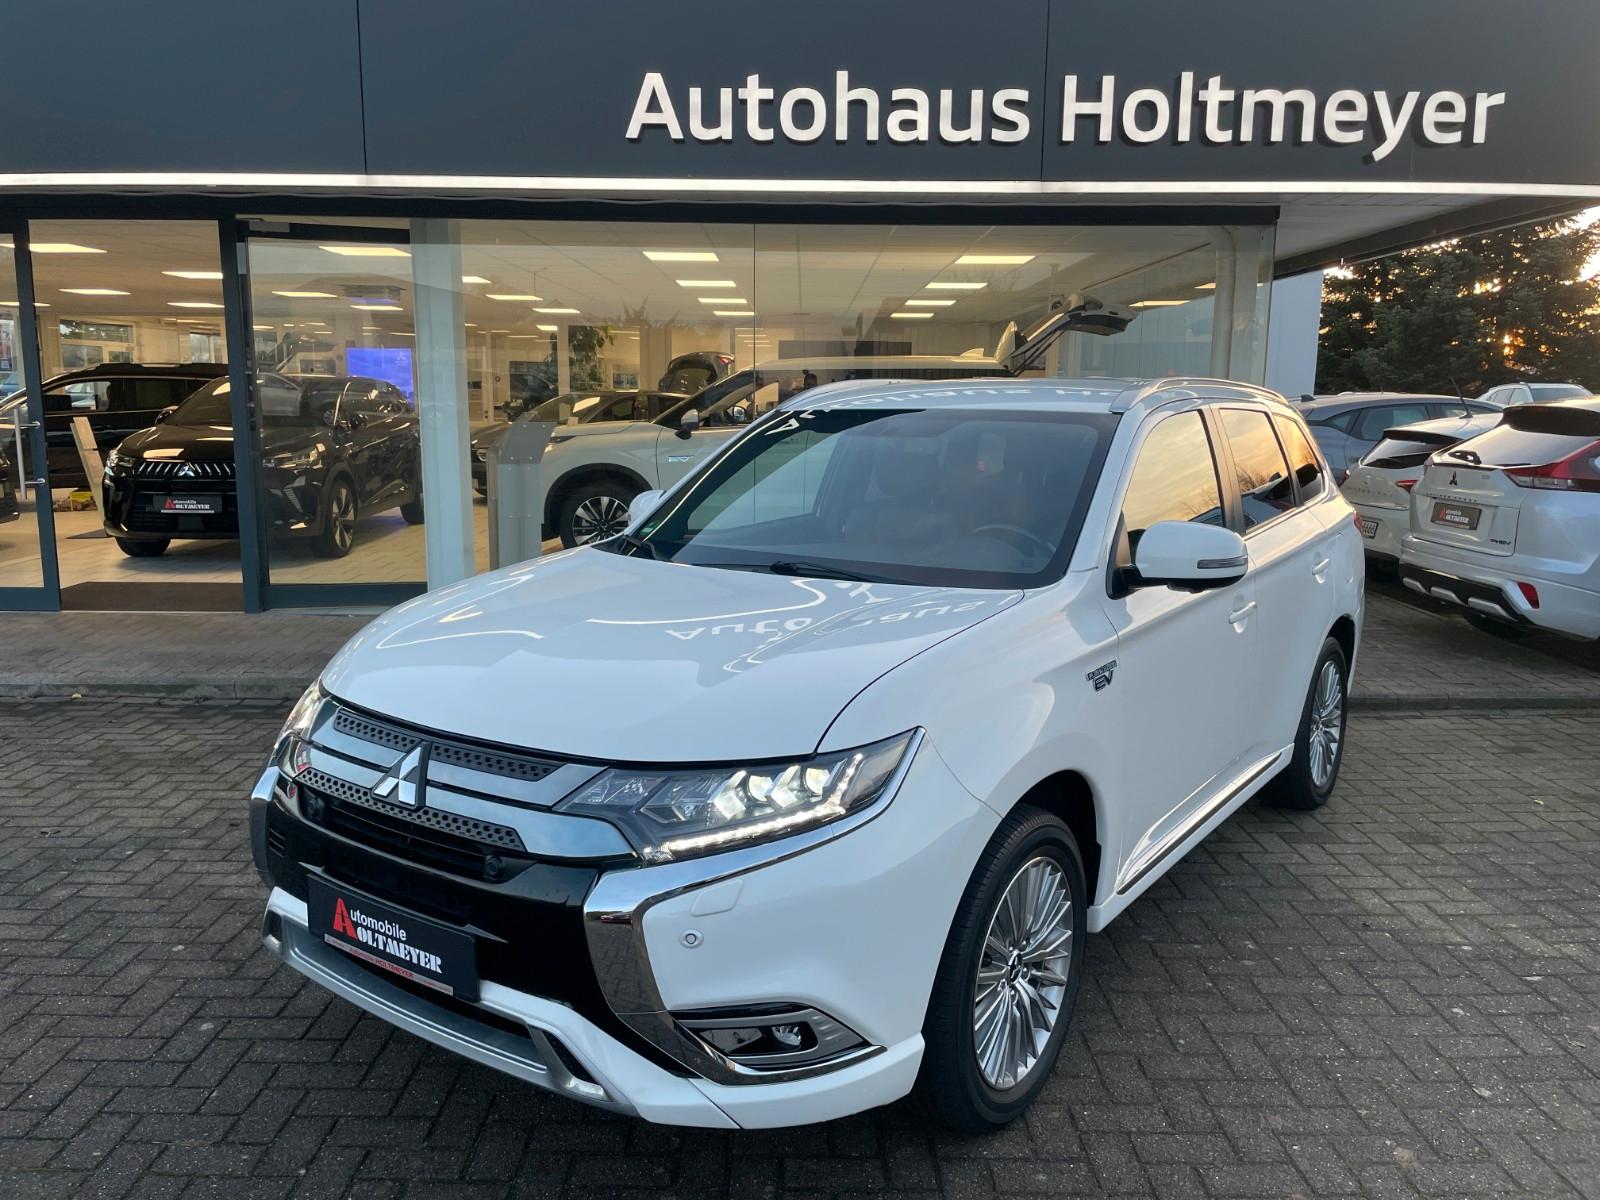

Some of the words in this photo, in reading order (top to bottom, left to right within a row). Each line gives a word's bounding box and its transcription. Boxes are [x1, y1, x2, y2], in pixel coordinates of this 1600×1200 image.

[624, 70, 1031, 143] Autohaus
[1060, 71, 1506, 163] Holtmeyer
[1092, 669, 1114, 691] EV
[333, 896, 407, 941] Automobile
